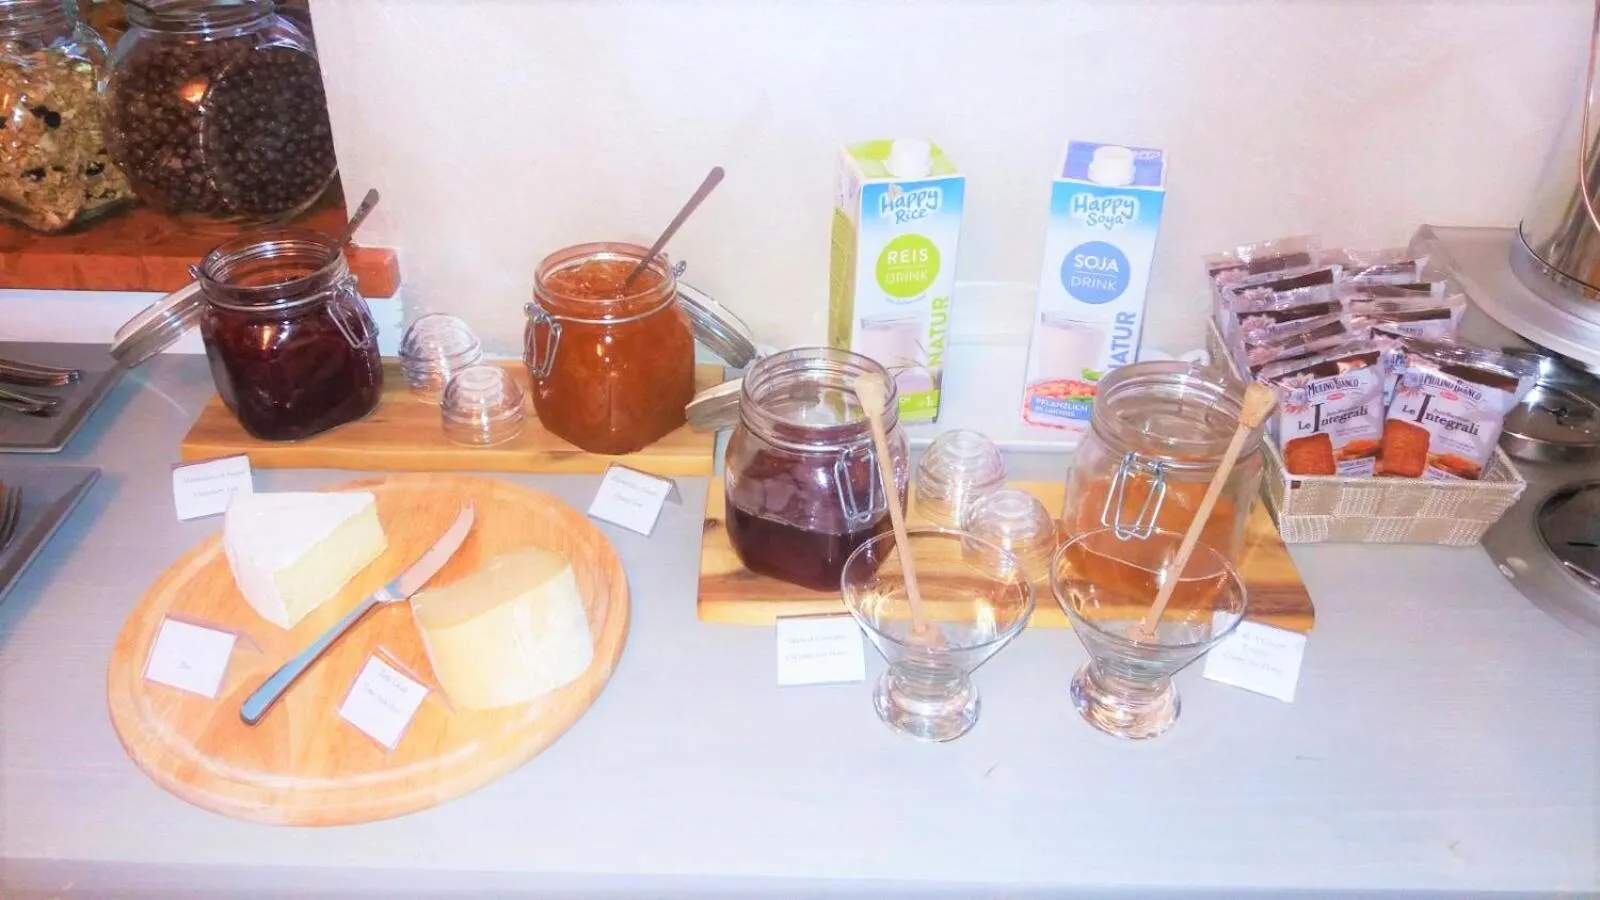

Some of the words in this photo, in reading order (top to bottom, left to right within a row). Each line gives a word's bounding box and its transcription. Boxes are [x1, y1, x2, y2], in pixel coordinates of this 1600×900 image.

[1073, 195, 1136, 221] Happy
[1085, 212, 1124, 231] Soya
[886, 247, 929, 266] REIS
[1073, 254, 1120, 273] SOJA
[885, 270, 928, 285] DRINK
[1070, 276, 1117, 291] DRINK
[927, 297, 949, 368] NATUR
[1107, 311, 1137, 369] ATUR
[1298, 420, 1312, 431] Le
[1311, 402, 1369, 434] Integrali
[1402, 404, 1416, 416] Le
[1412, 392, 1481, 436] Integrali
